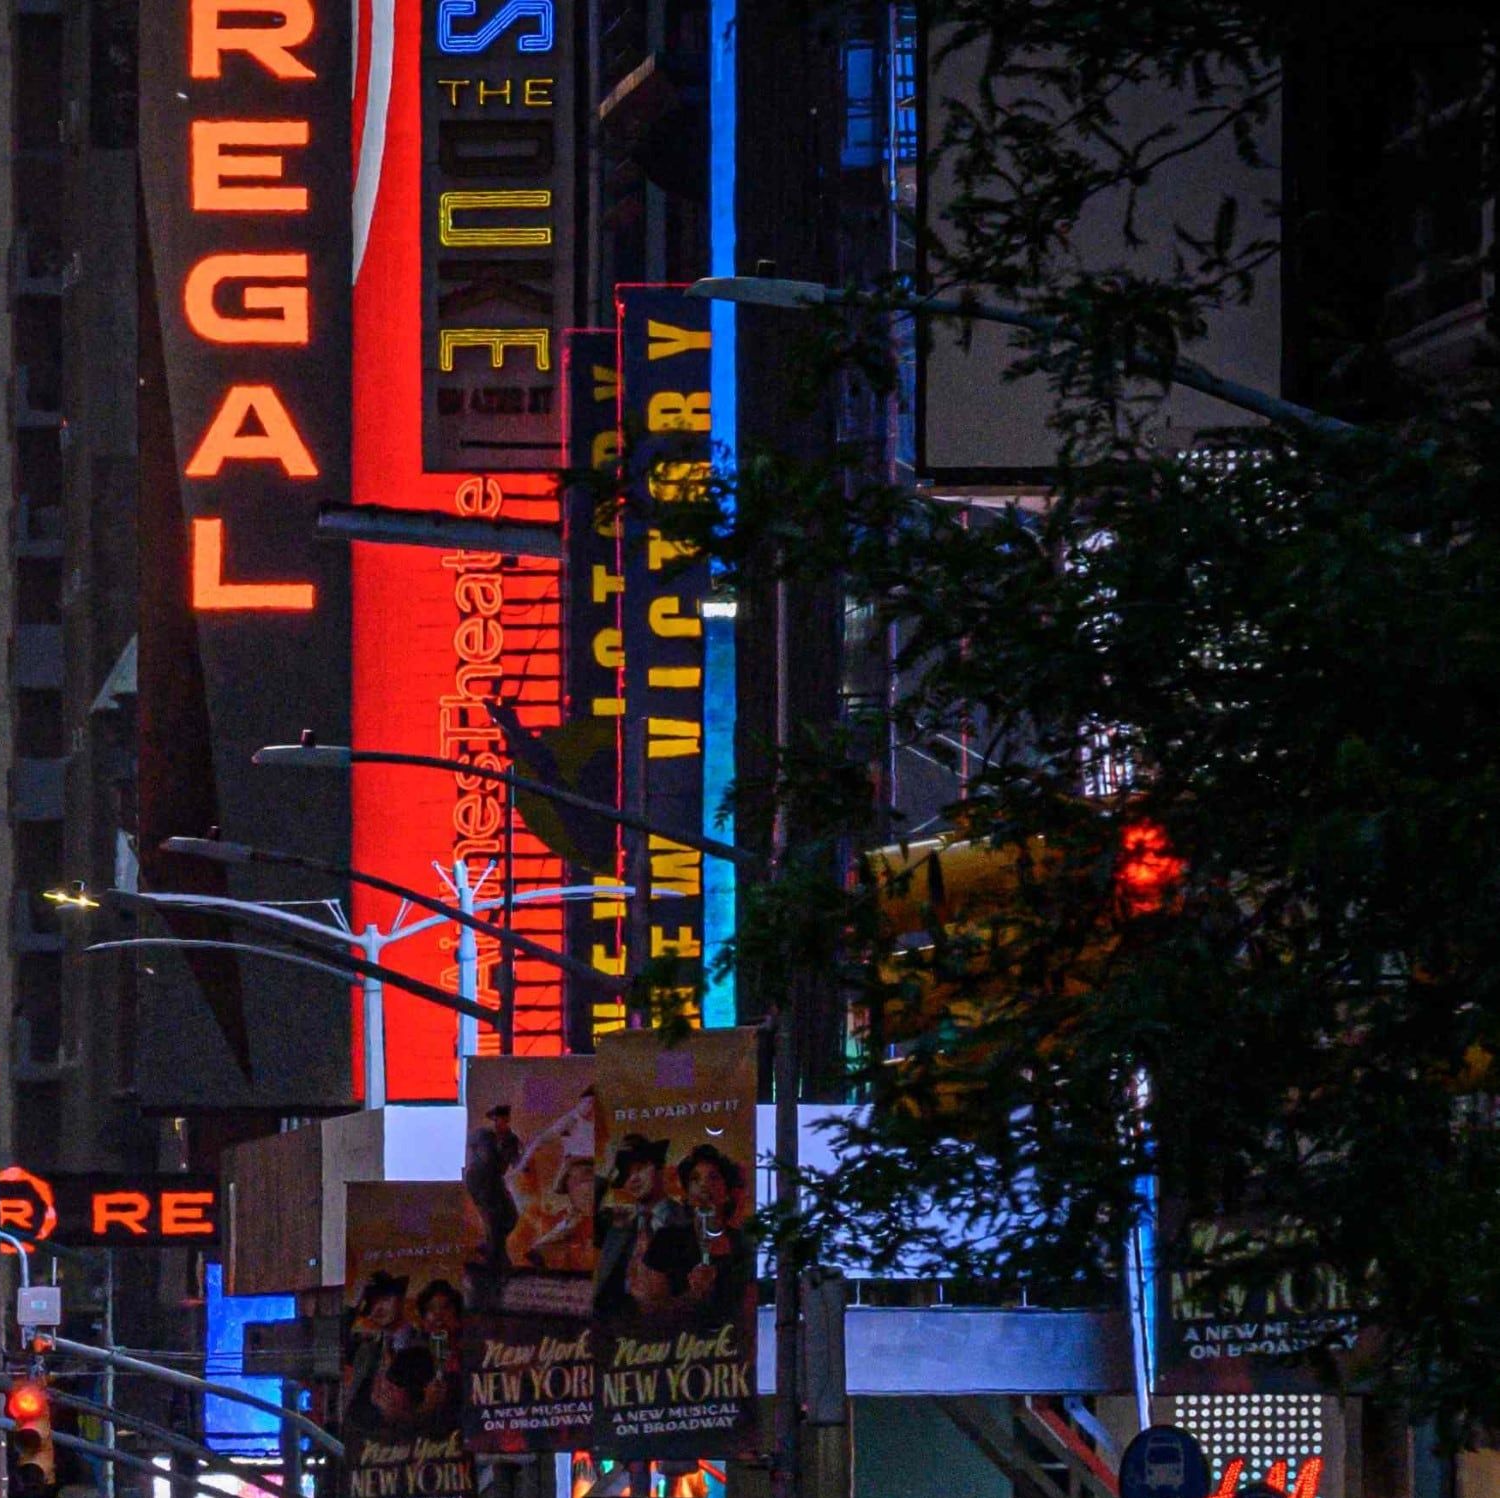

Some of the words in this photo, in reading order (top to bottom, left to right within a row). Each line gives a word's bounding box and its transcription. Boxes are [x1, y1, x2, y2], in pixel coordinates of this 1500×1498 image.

[438, 78, 553, 107] THE
[438, 118, 553, 372] DUKE
[186, 0, 318, 609] REGAL
[653, 1103, 697, 1118] PART
[701, 1101, 722, 1114] OF
[472, 1371, 523, 1406] NEW
[602, 1373, 658, 1408] NEW
[666, 1362, 752, 1402] YORK
[480, 1406, 491, 1420] A
[493, 1404, 529, 1419] NEW
[483, 1418, 506, 1432] ON
[509, 1413, 594, 1431] BROADWAY
[611, 1411, 624, 1424] A
[627, 1409, 664, 1423] NEW
[669, 1402, 740, 1419] MUSICAL
[615, 1423, 639, 1437] ON
[643, 1415, 737, 1435] BROADWAY
[405, 1461, 474, 1496] YORK
